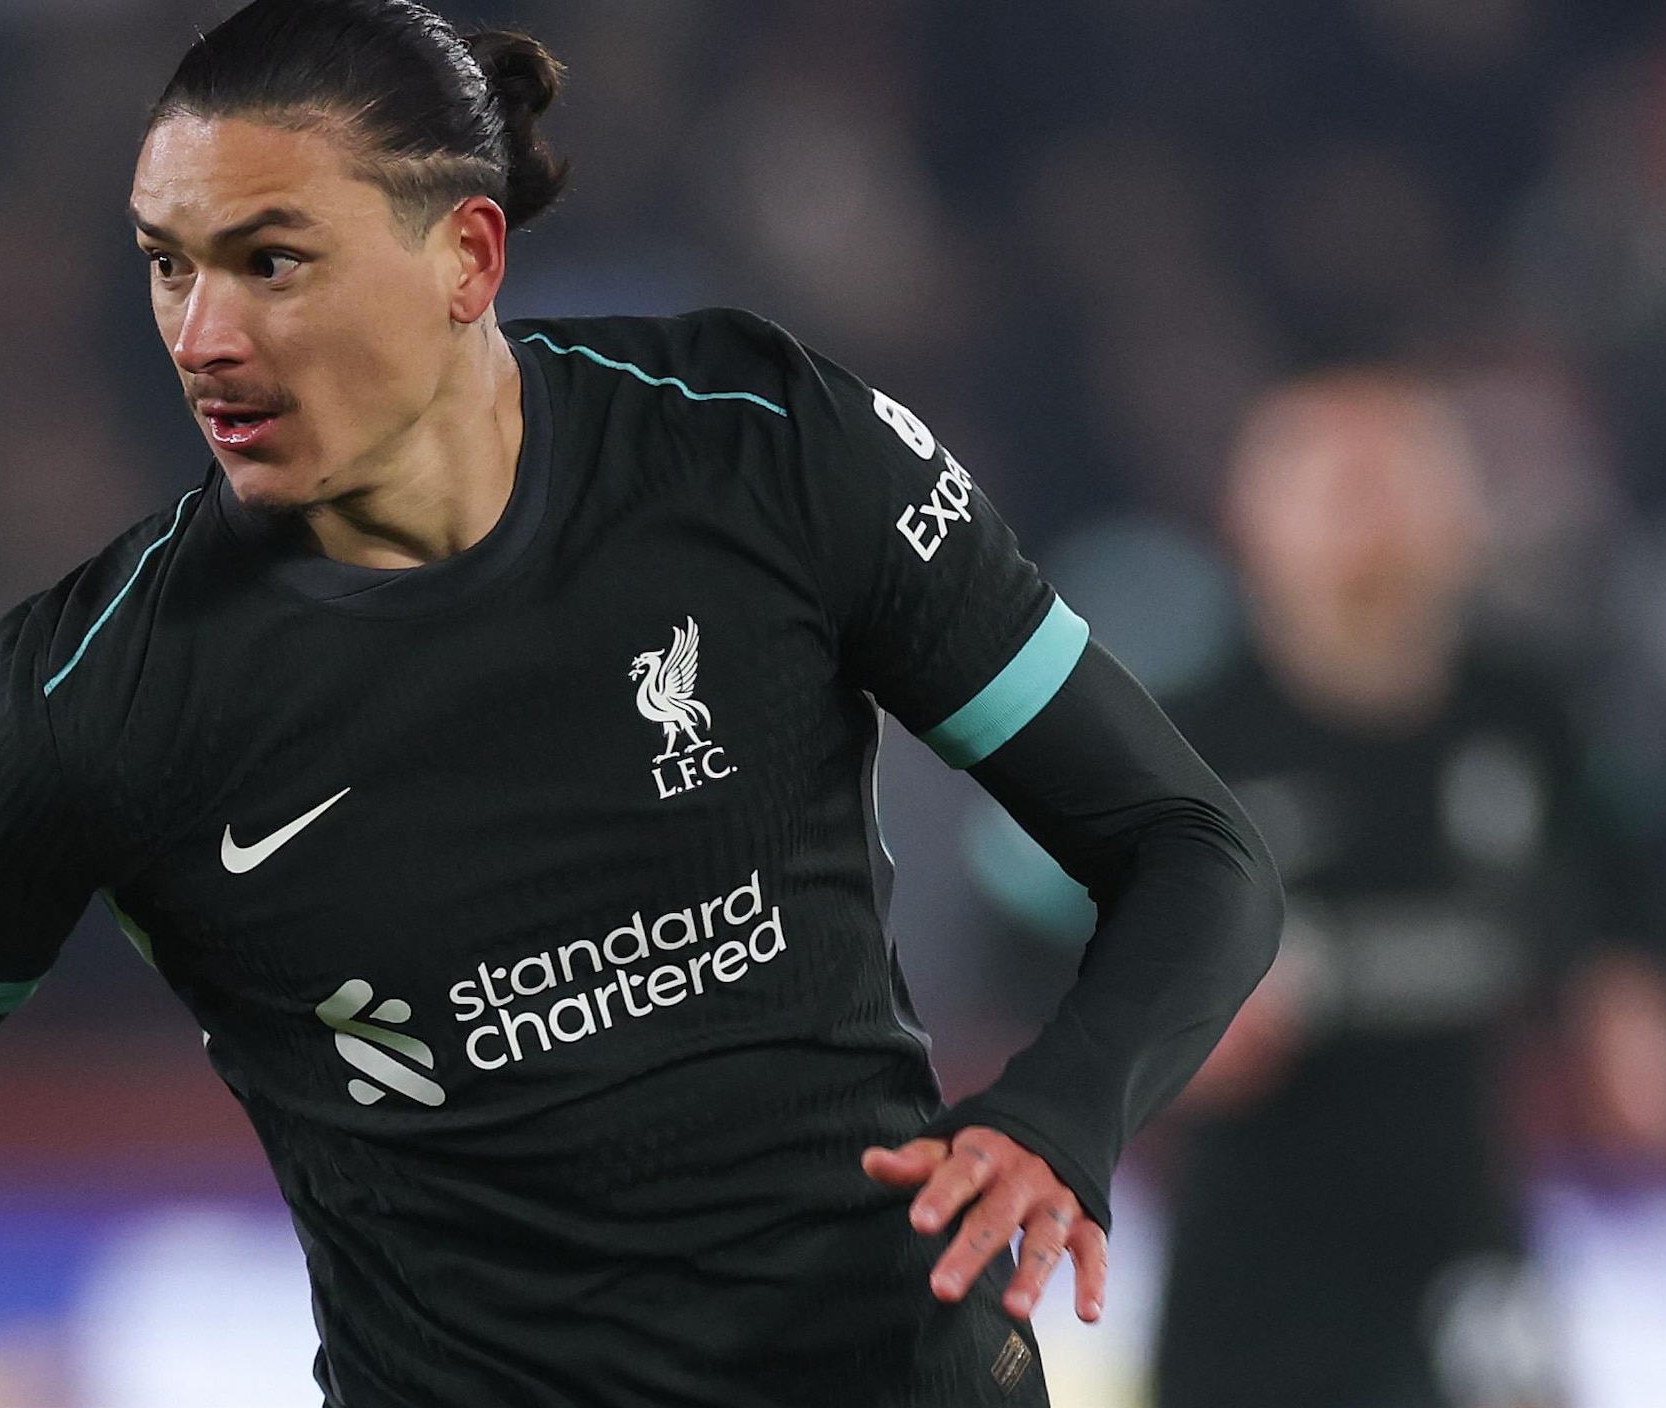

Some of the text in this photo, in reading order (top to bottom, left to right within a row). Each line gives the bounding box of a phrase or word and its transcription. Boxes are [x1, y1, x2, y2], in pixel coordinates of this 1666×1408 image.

[896, 446, 973, 562] Expe
[651, 747, 738, 799] L.F.C.
[449, 868, 763, 1022] standard
[465, 905, 787, 1070] chartered
